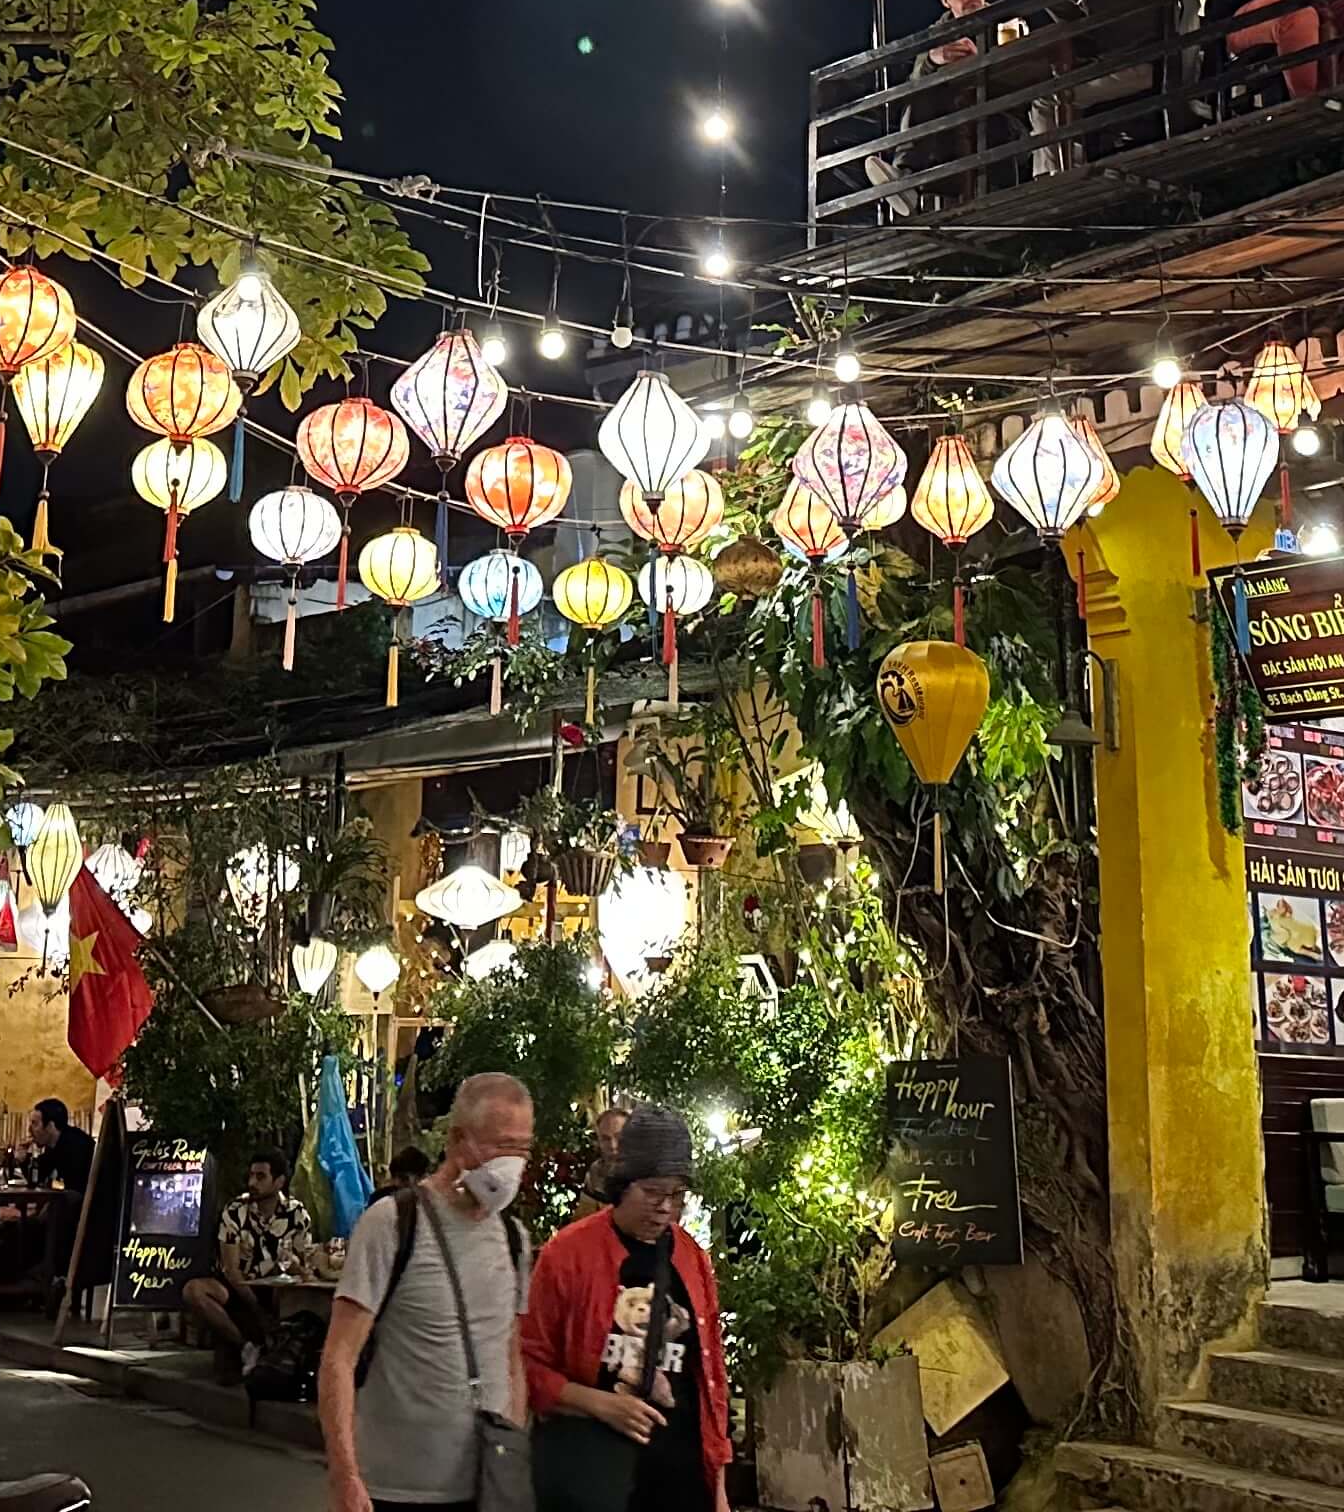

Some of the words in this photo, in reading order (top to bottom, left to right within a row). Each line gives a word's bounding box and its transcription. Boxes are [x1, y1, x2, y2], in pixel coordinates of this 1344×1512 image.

[1256, 577, 1289, 595] HÀNG
[1248, 610, 1312, 647] SÔNG
[1308, 653, 1327, 672] HỘI
[1250, 855, 1275, 884] HẢI
[1277, 858, 1306, 888] SẢN
[1308, 866, 1340, 891] TƯƠI
[894, 1066, 960, 1113] Happy
[945, 1097, 995, 1120] hour
[899, 1172, 998, 1212] Free
